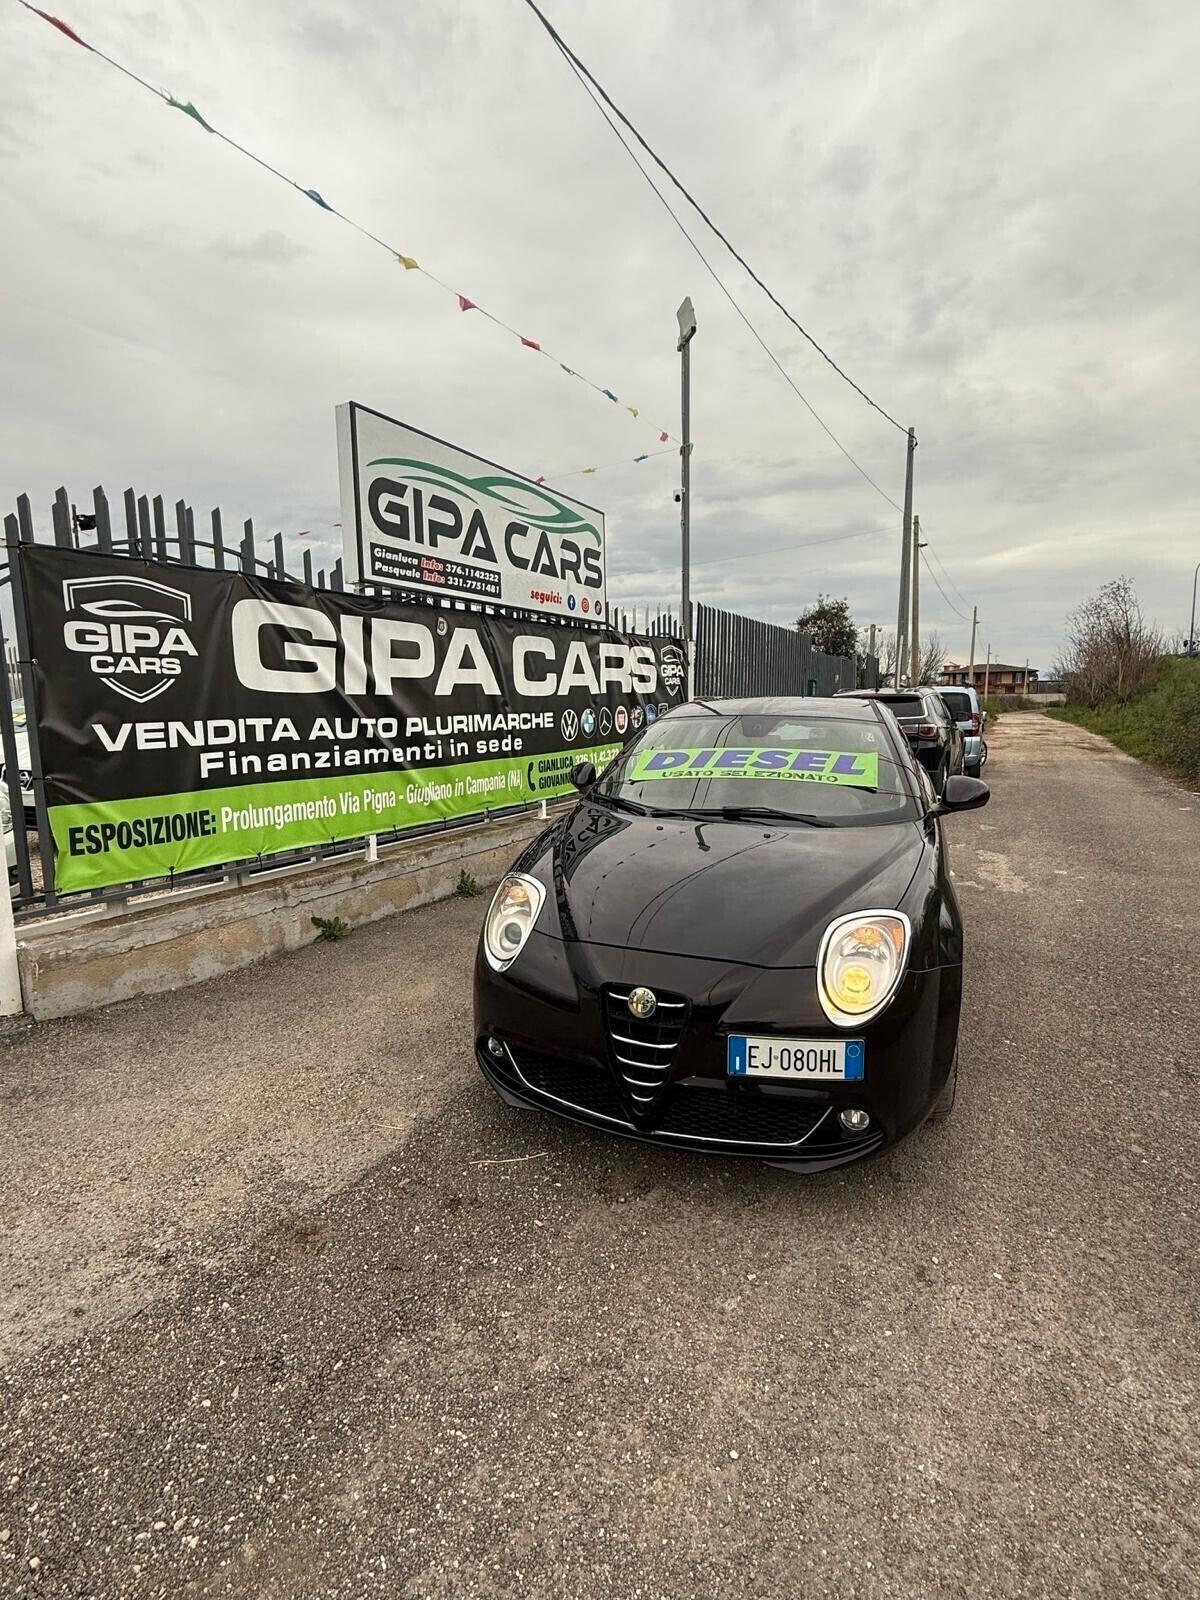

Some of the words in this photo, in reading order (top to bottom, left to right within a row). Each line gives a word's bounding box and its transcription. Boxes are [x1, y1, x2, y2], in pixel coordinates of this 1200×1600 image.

[368, 476, 498, 563] GIPA
[504, 521, 602, 589] CARS
[374, 547, 419, 565] Gianluca
[421, 557, 444, 571] Info:
[446, 563, 499, 582] 376.1142322
[375, 561, 421, 578] Pasquale
[423, 570, 446, 584] Info:
[447, 576, 500, 594] 331.7751481
[530, 590, 562, 604] seguici:
[63, 621, 199, 657] GIPA
[231, 598, 501, 696] GIPA
[512, 635, 657, 697] CARS
[90, 655, 182, 675] CARS
[660, 664, 684, 677] GIPA
[91, 718, 300, 752] VENDITA
[308, 717, 398, 740] AUTO
[406, 711, 554, 737] PLURIMARCHE
[200, 741, 443, 779] Finanziamenti
[449, 739, 469, 757] in
[476, 734, 523, 753] sede
[538, 755, 574, 773] GIANLUCA
[643, 750, 866, 776] DIESEL
[538, 772, 572, 789] GIOVANN
[661, 769, 714, 778] USATO
[720, 769, 839, 783] SELEZIONATO
[69, 809, 217, 856] ESPOSIZIONE:
[221, 798, 337, 833] Prolungamento
[339, 792, 360, 814] Via
[364, 789, 396, 814] Pigna
[406, 780, 452, 806] Giugliano
[455, 781, 465, 797] in
[466, 773, 505, 796] Campania
[507, 769, 523, 790] (NA)
